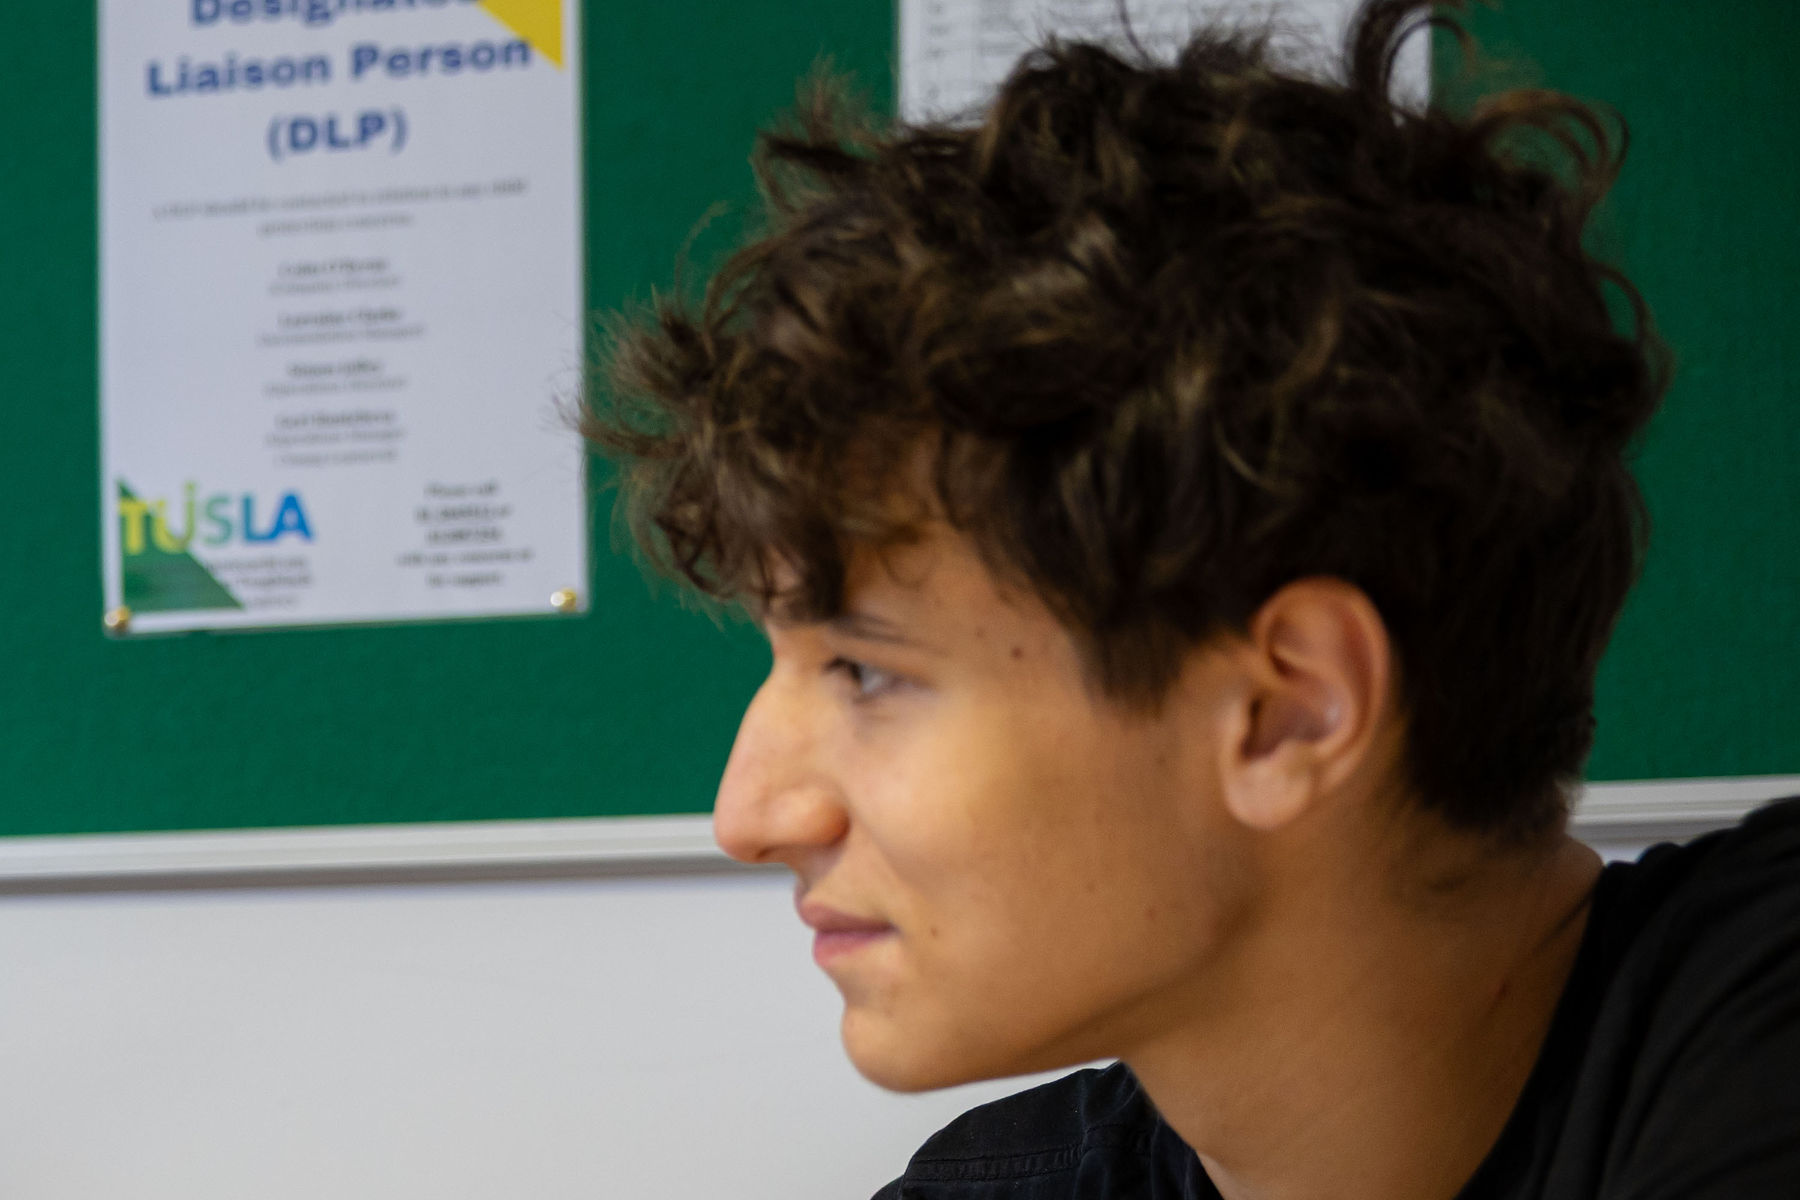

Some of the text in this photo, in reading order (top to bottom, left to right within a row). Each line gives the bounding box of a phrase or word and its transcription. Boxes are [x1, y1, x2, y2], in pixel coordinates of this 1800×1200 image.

[146, 38, 533, 96] Liaison Person
[267, 109, 409, 160] (DLP)
